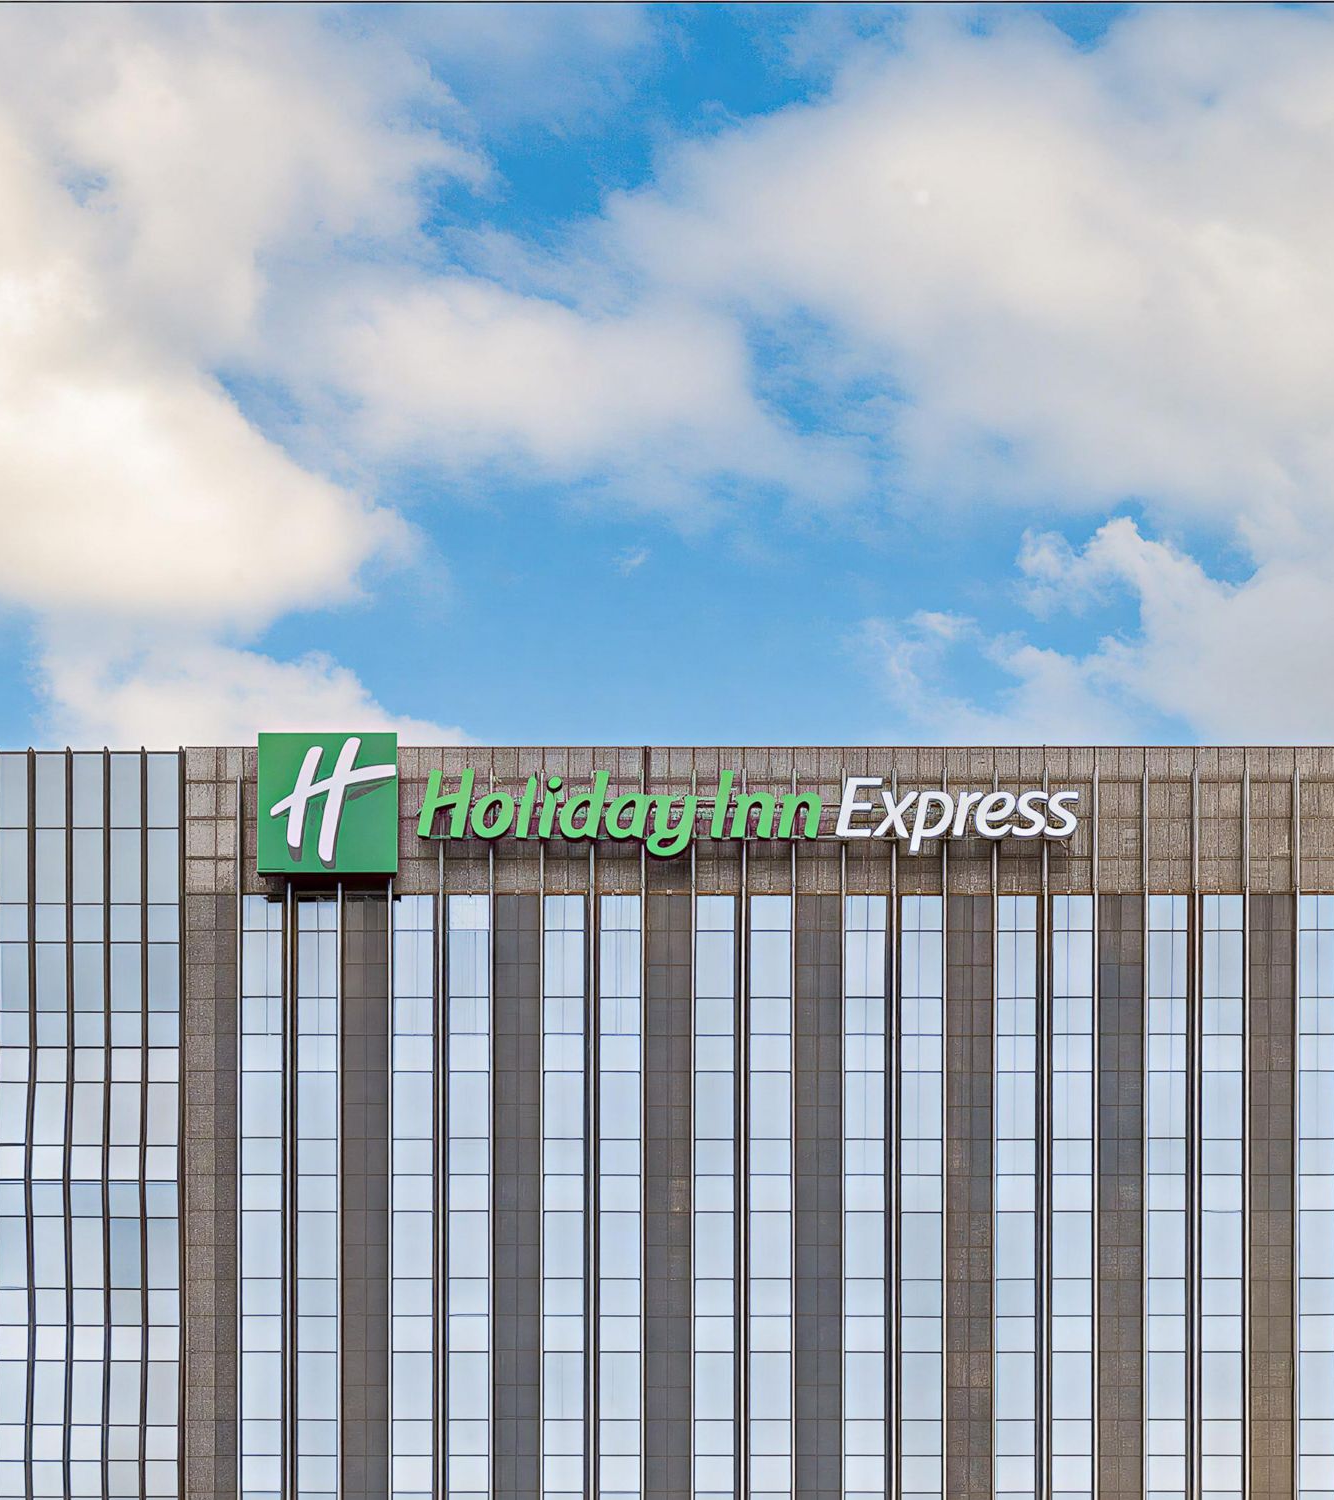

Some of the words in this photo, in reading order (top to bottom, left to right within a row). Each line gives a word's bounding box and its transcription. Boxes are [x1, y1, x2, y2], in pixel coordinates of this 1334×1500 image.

[269, 736, 397, 863] H
[416, 767, 697, 857] Holiday
[709, 769, 822, 840] Inn
[834, 776, 1080, 856] Express
